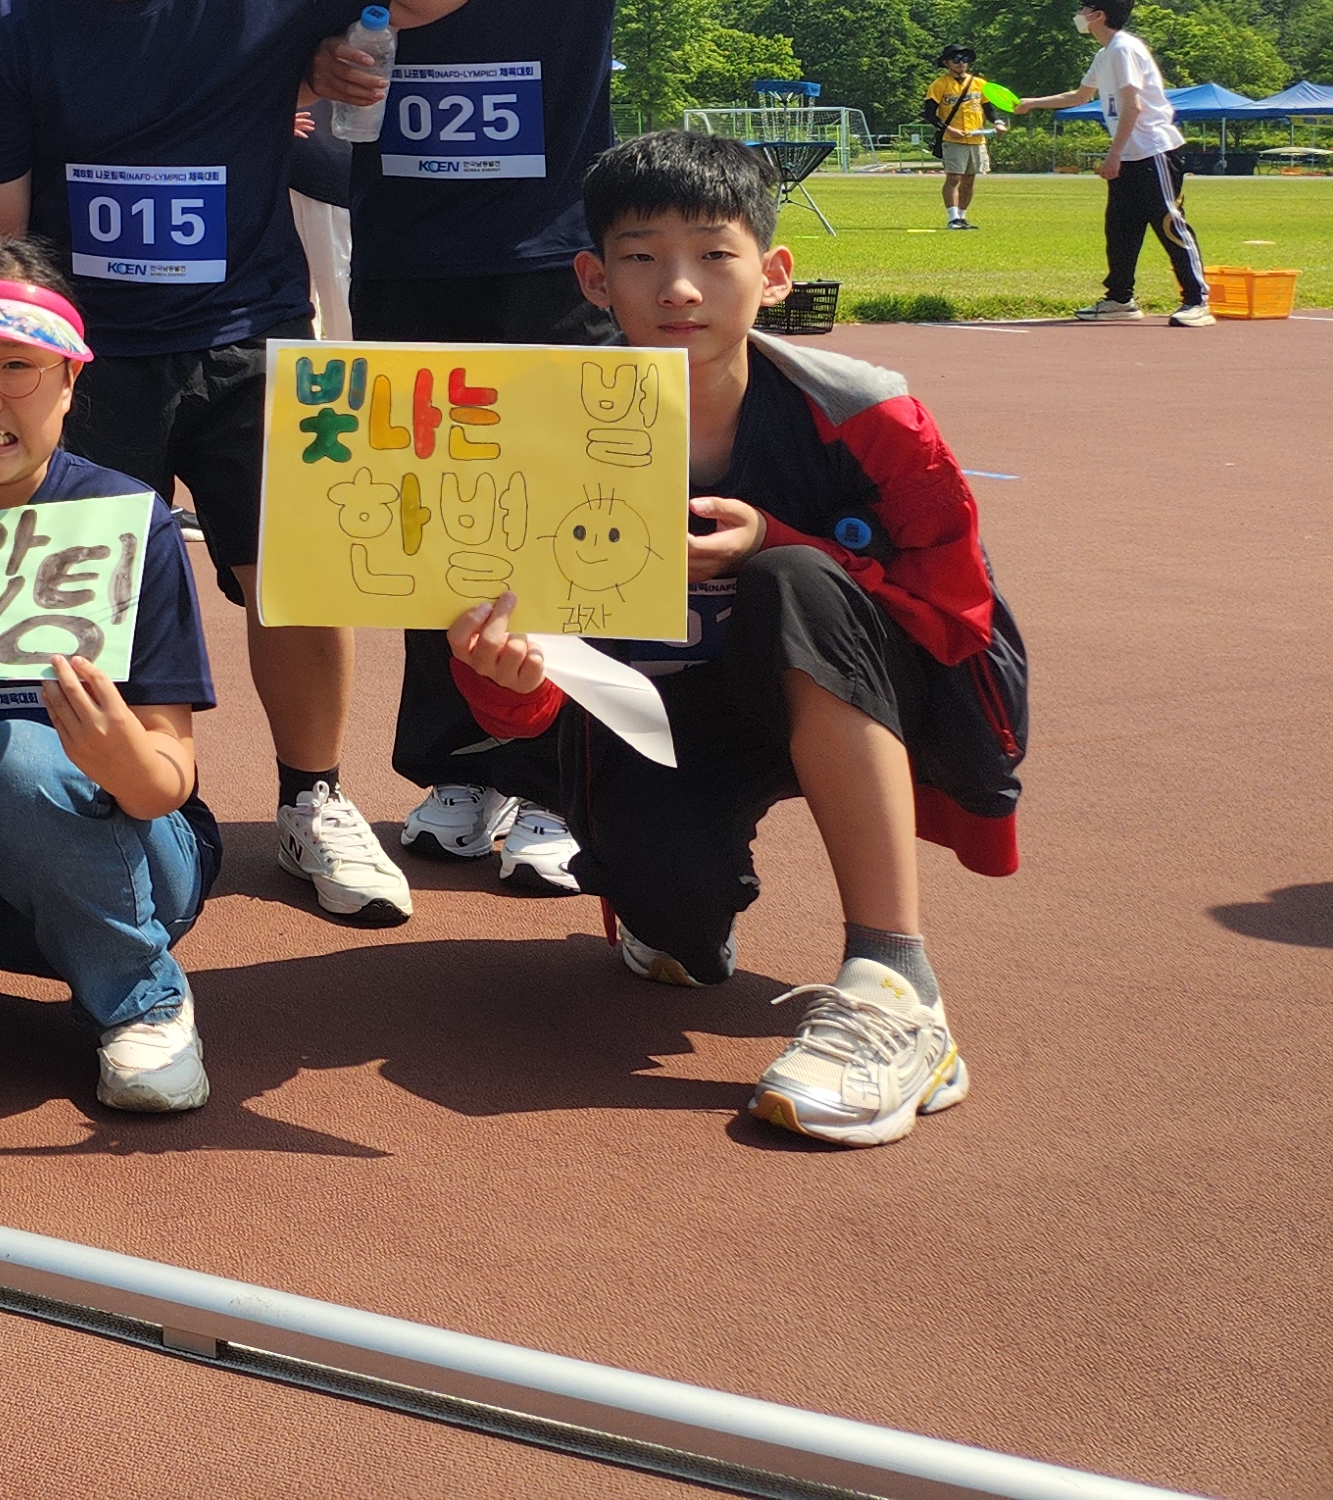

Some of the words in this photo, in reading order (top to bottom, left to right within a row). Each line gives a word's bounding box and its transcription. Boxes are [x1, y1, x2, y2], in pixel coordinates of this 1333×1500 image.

[398, 93, 520, 141] 025
[418, 160, 460, 173] KOEN
[88, 195, 206, 245] 015
[107, 262, 147, 275] KOEN
[295, 356, 501, 465] 빛나는
[580, 361, 660, 468] 별
[326, 466, 529, 600] 한별
[558, 604, 613, 634] 감자
